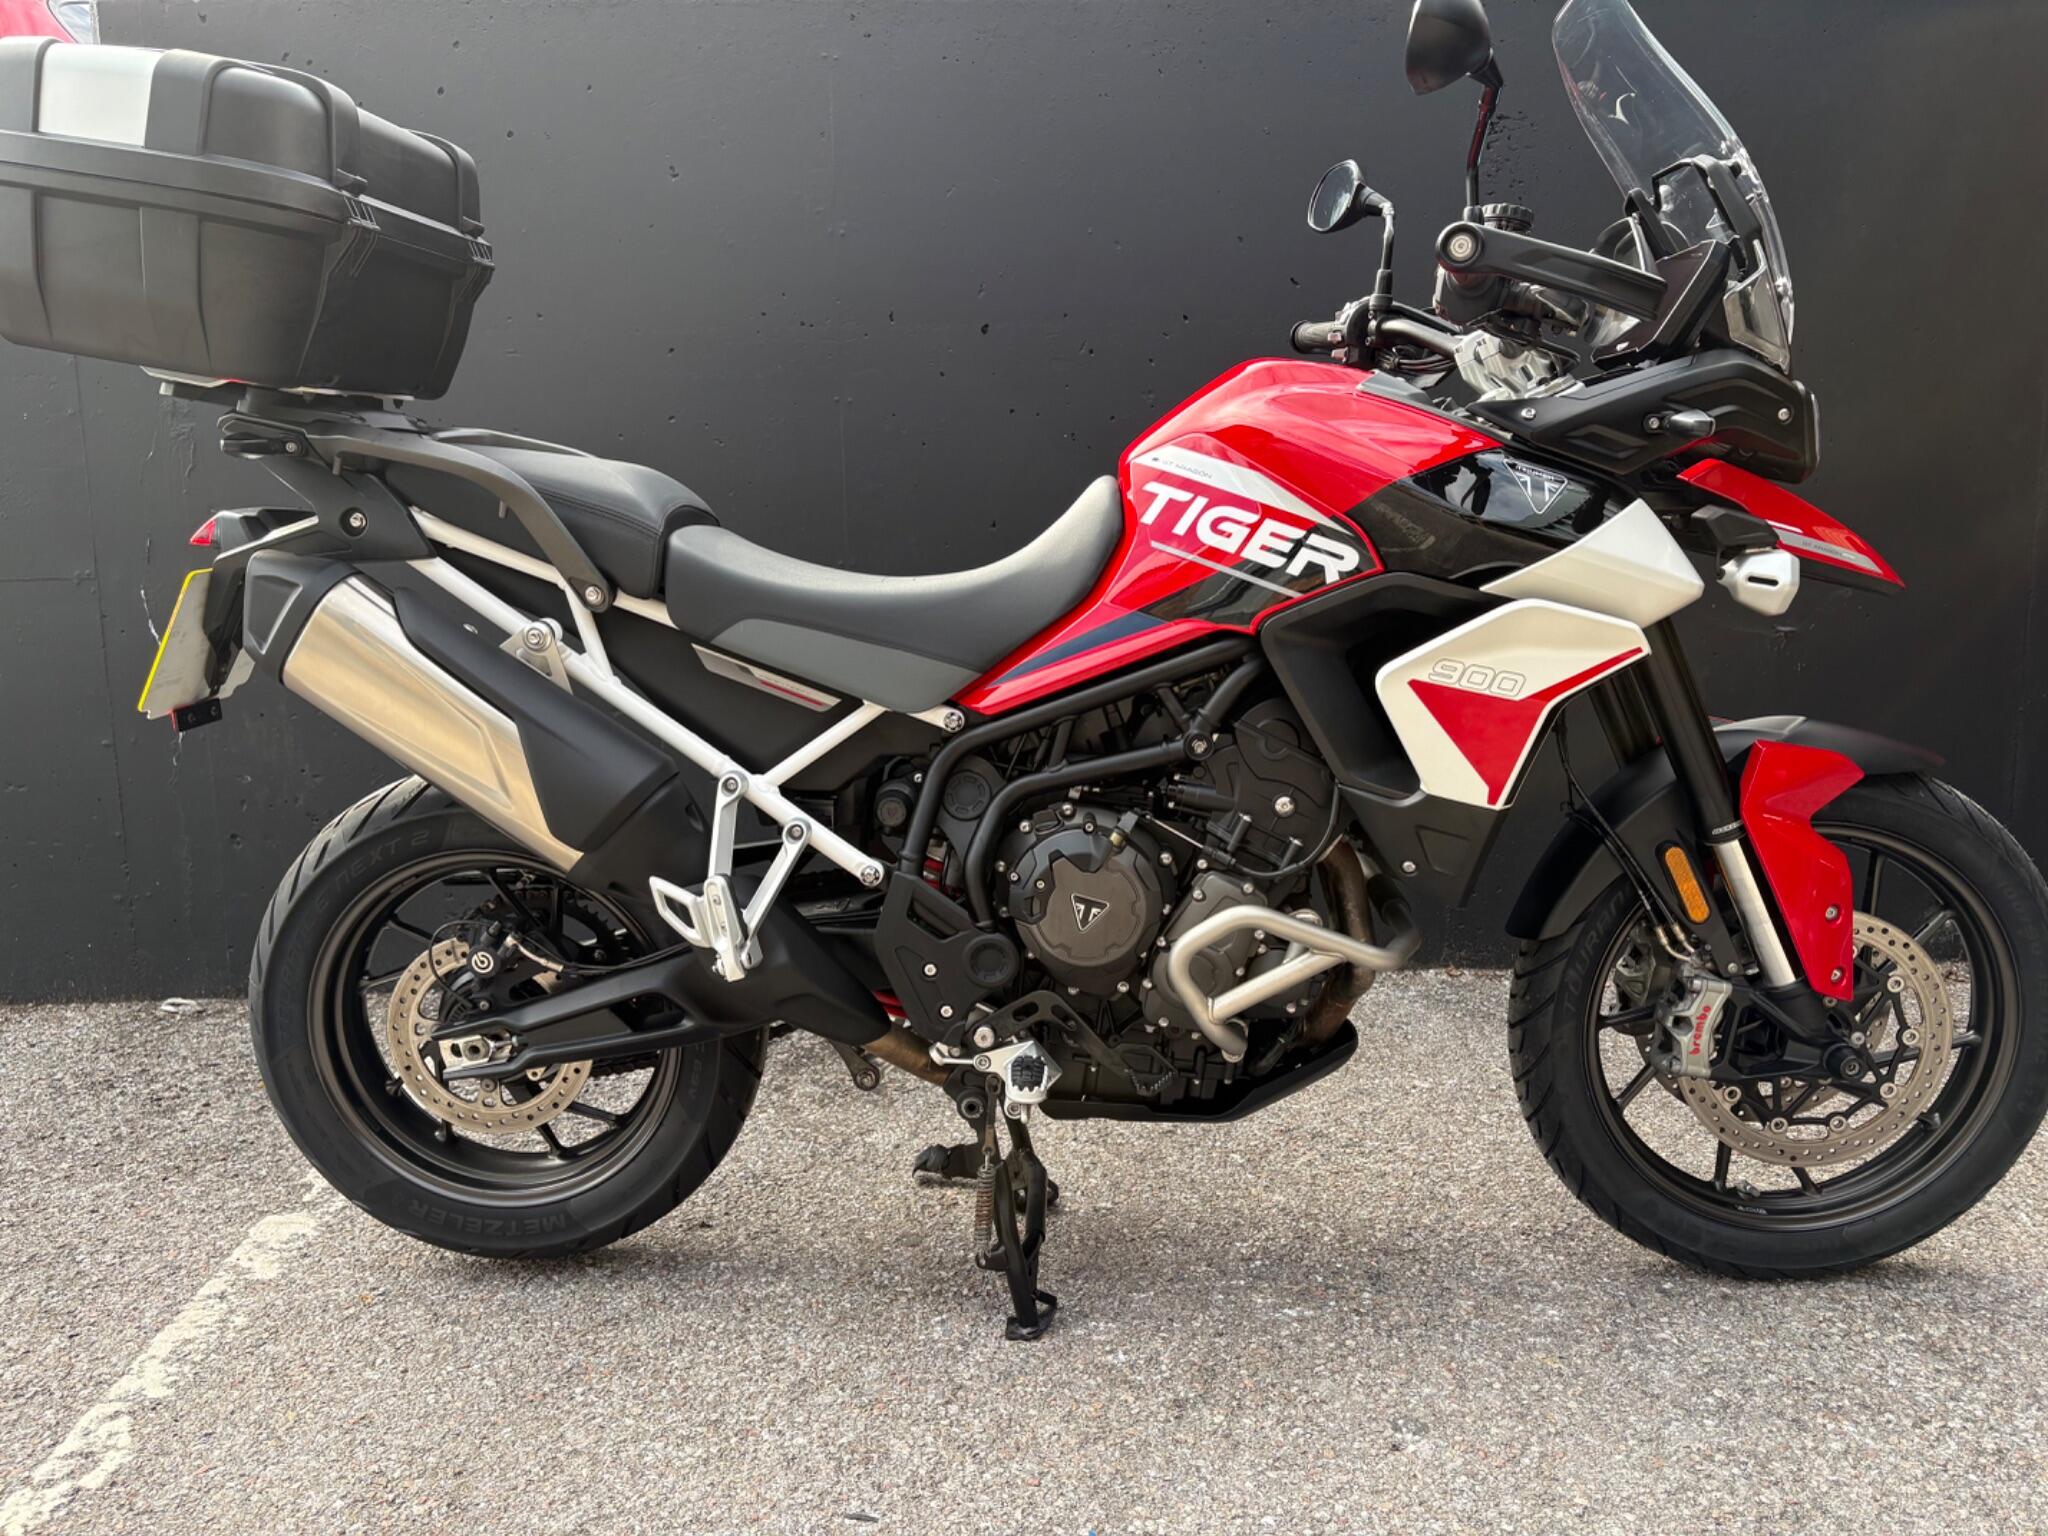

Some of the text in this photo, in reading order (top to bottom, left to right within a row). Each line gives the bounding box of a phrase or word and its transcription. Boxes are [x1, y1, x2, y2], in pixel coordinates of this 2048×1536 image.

[1140, 481, 1360, 585] TIGER
[1428, 658, 1527, 698] 900
[411, 831, 430, 847] 2
[1564, 879, 1632, 1013] TOURAN
[1689, 1005, 1711, 1056] brembo
[408, 1200, 567, 1237] METZELER
